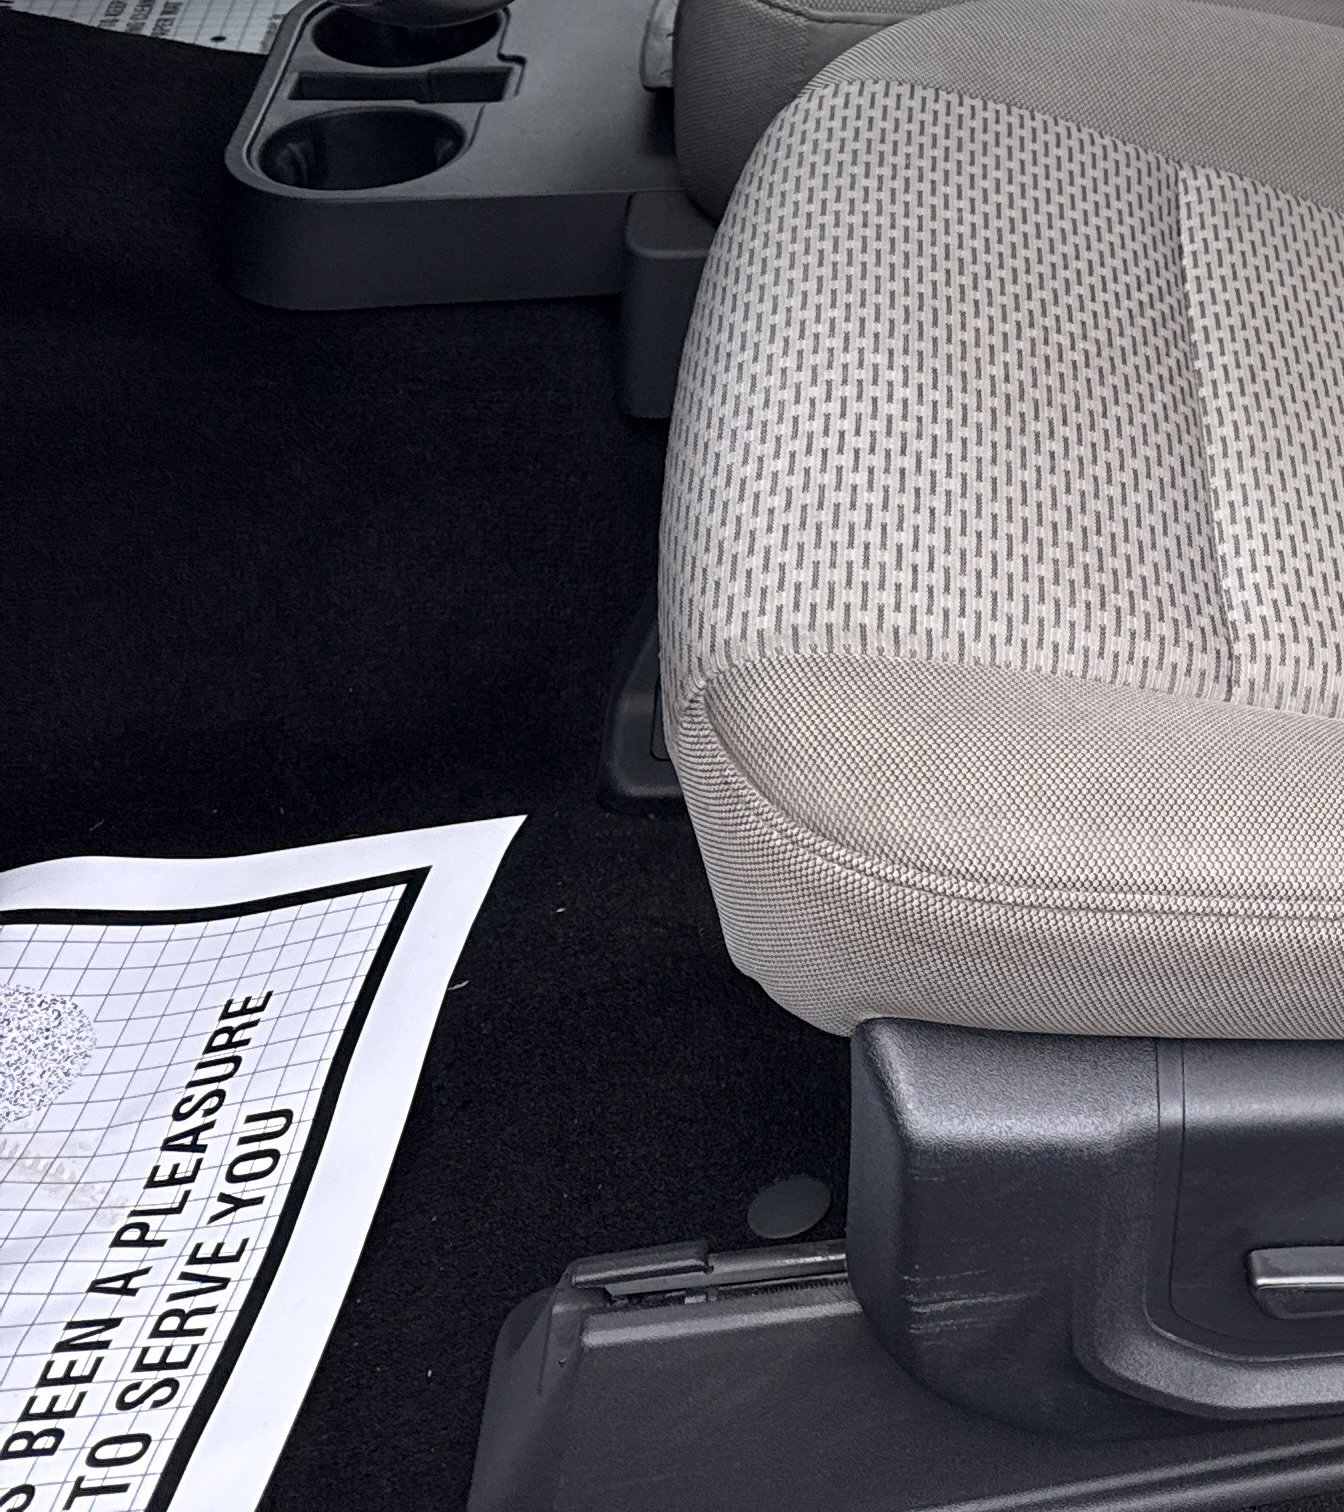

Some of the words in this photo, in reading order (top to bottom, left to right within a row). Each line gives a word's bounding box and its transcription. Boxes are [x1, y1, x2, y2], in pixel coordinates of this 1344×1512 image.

[108, 990, 274, 1249] PLEASURE
[62, 1432, 152, 1511] TO
[114, 1236, 250, 1412] SERVE
[206, 1108, 294, 1226] YOU
[86, 1265, 153, 1297] A
[0, 1316, 124, 1461] BEEN
